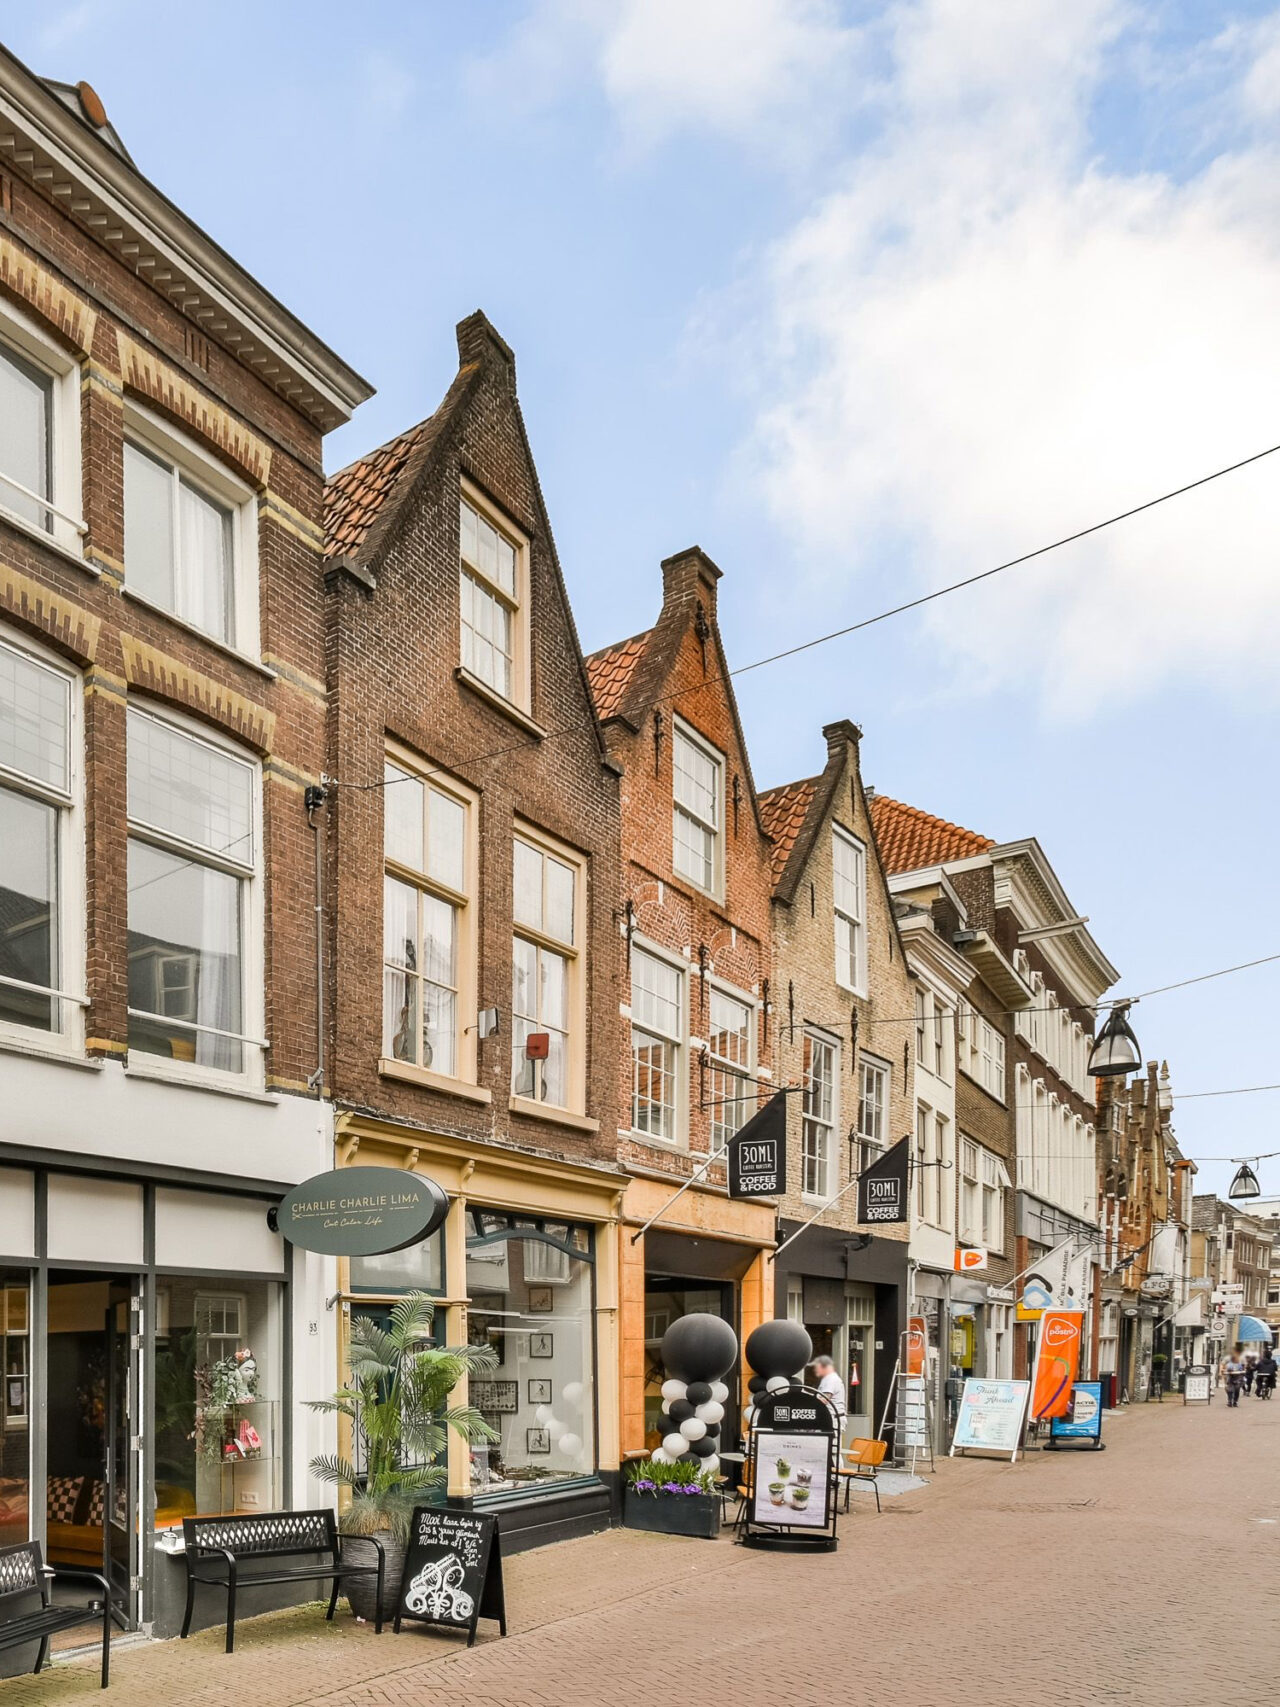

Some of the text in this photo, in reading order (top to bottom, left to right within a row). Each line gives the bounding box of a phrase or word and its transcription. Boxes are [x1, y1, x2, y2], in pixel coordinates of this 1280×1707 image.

[742, 1144, 773, 1164] 30ML
[739, 1175, 777, 1184] COFFEE
[740, 1182, 777, 1192] &FOOD
[870, 1181, 897, 1198] 30ML
[291, 1193, 420, 1213] CHARLIE CHARLIE LIMA
[867, 1206, 899, 1214] COFFEE
[867, 1212, 899, 1220] &FOOD
[1061, 1250, 1069, 1282] PARADISE
